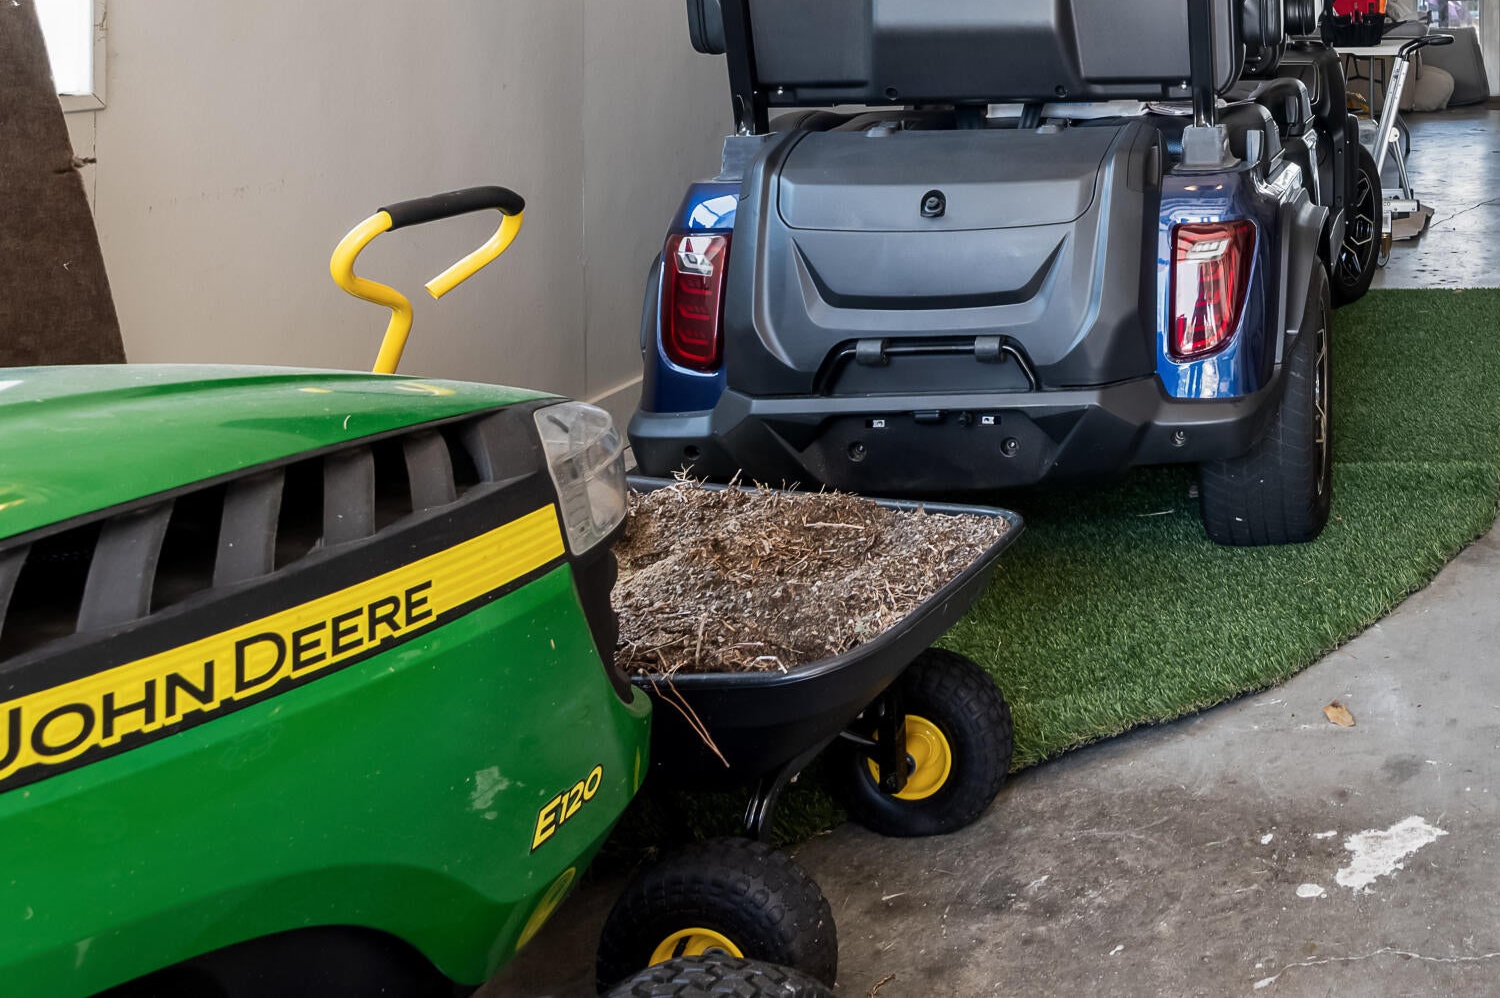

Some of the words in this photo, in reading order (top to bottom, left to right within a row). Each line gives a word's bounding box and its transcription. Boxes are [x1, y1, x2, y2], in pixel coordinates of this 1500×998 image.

[0, 661, 214, 770] JOHN
[235, 580, 433, 693] DEERE
[531, 763, 603, 854] E120
